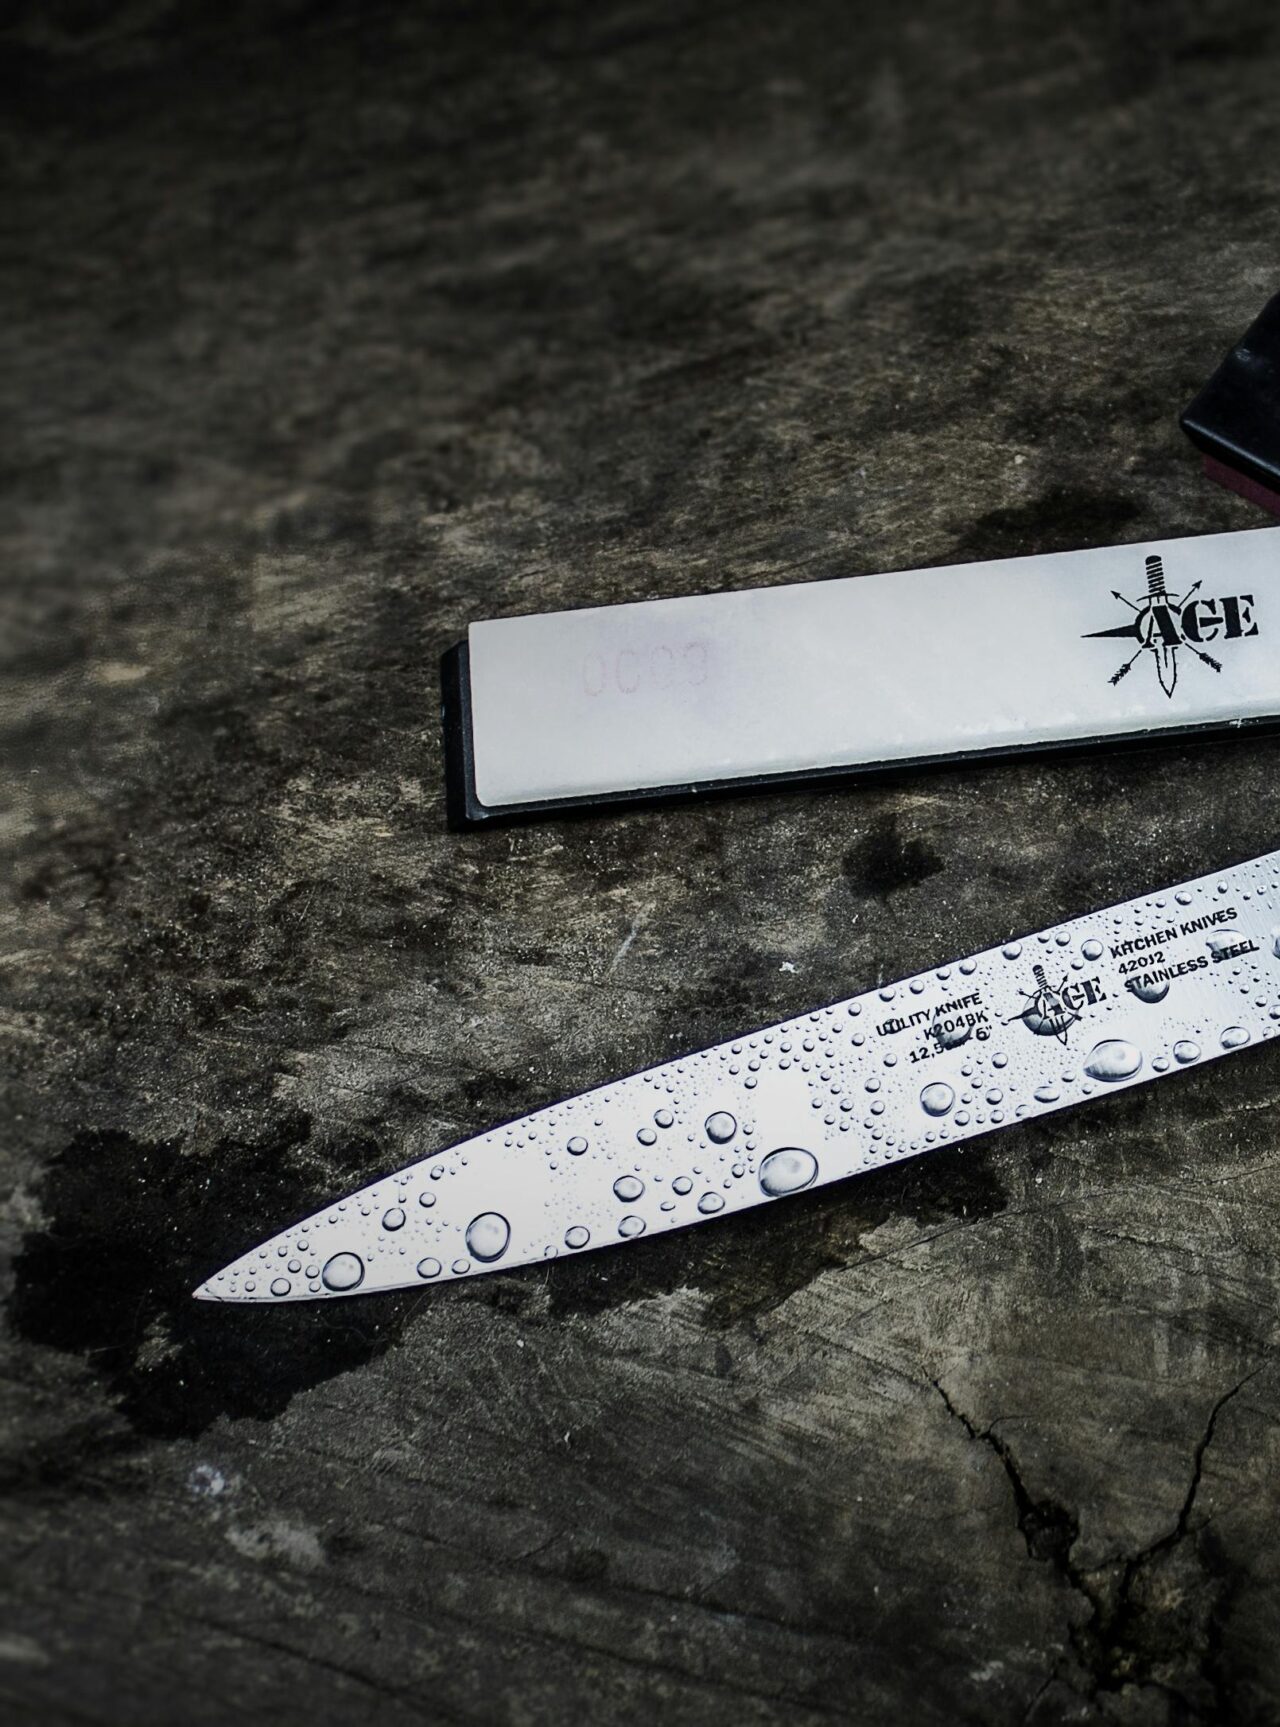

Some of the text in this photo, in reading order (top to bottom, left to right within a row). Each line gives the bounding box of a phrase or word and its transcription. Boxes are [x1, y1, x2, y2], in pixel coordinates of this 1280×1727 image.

[1110, 907, 1238, 959] KITCHEN KNIVES
[1118, 951, 1166, 975] 420J2
[1124, 939, 1260, 992] STAINLESS STEEL
[935, 992, 982, 1017] KNIFE
[923, 1010, 989, 1041] K204BK
